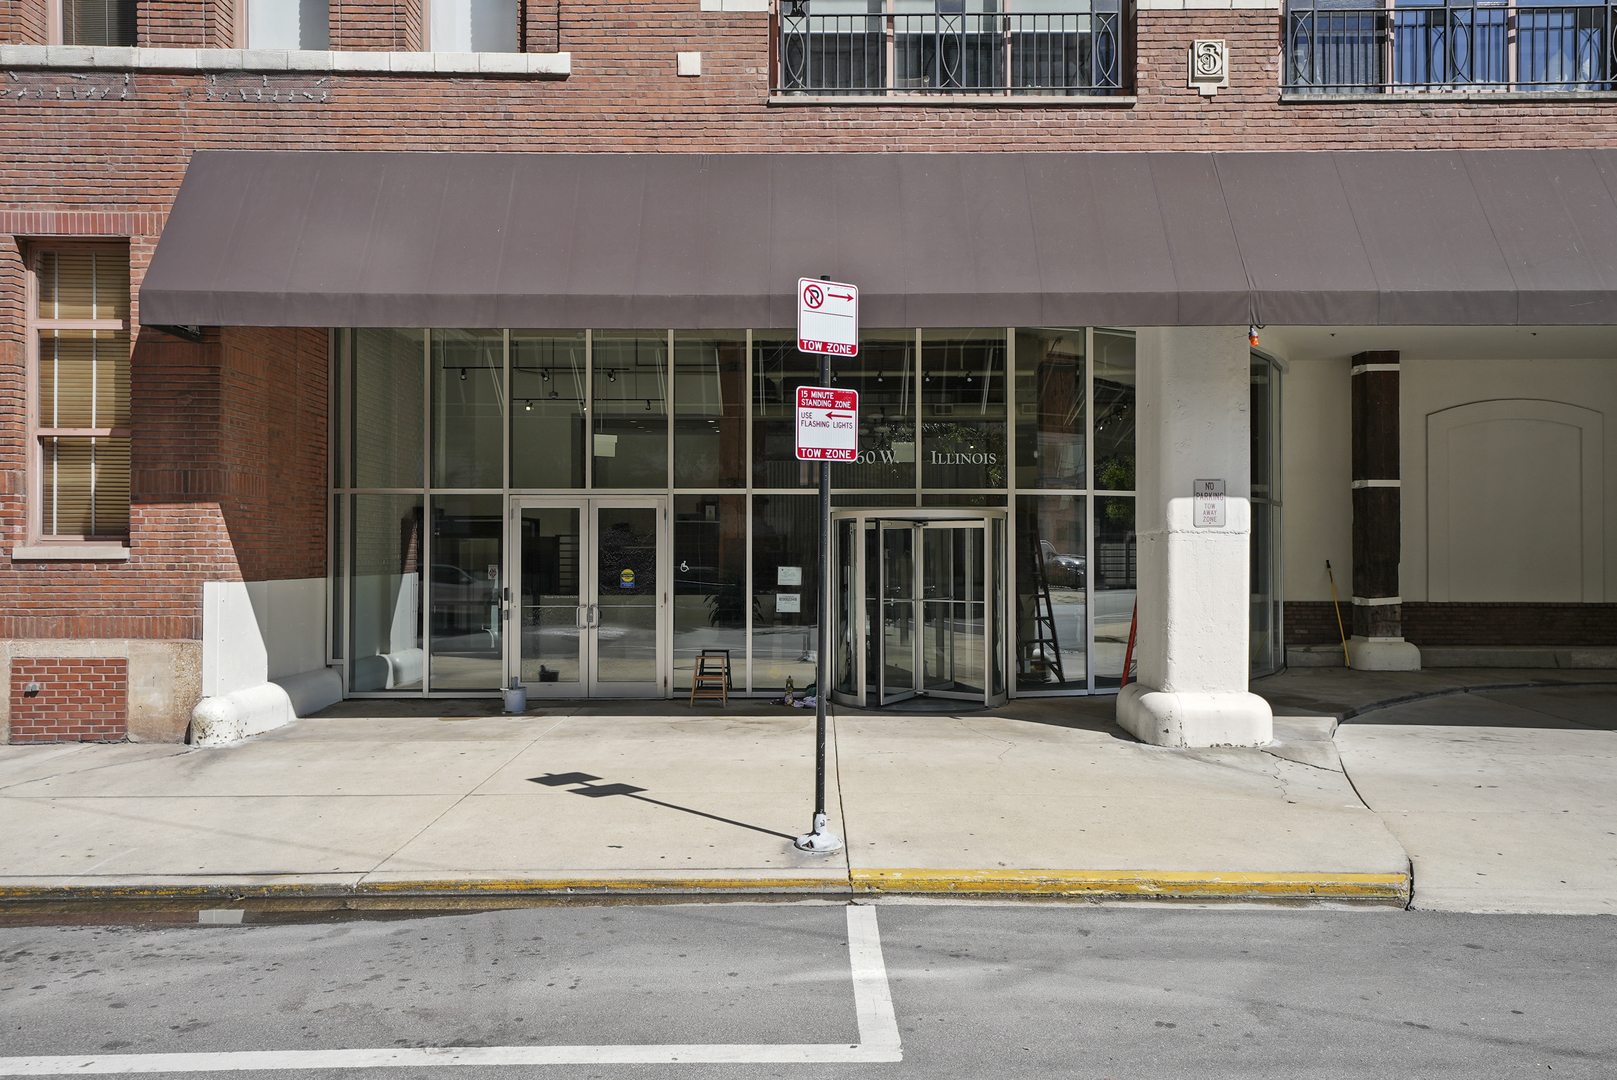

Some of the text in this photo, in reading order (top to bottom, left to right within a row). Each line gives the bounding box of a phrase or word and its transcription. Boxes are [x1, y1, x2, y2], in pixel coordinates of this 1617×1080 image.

[802, 340, 853, 354] TOW ZONE
[800, 390, 835, 400] 15 MINUTE
[800, 398, 852, 409] STANDING ZONE
[800, 411, 813, 420] USE
[800, 419, 853, 430] FLASHING LIGHTS
[800, 448, 852, 459] TOW ZONE
[846, 450, 997, 465] 60 W. ILLINOIS
[1205, 482, 1214, 490] NO
[1196, 492, 1224, 500] PARKING
